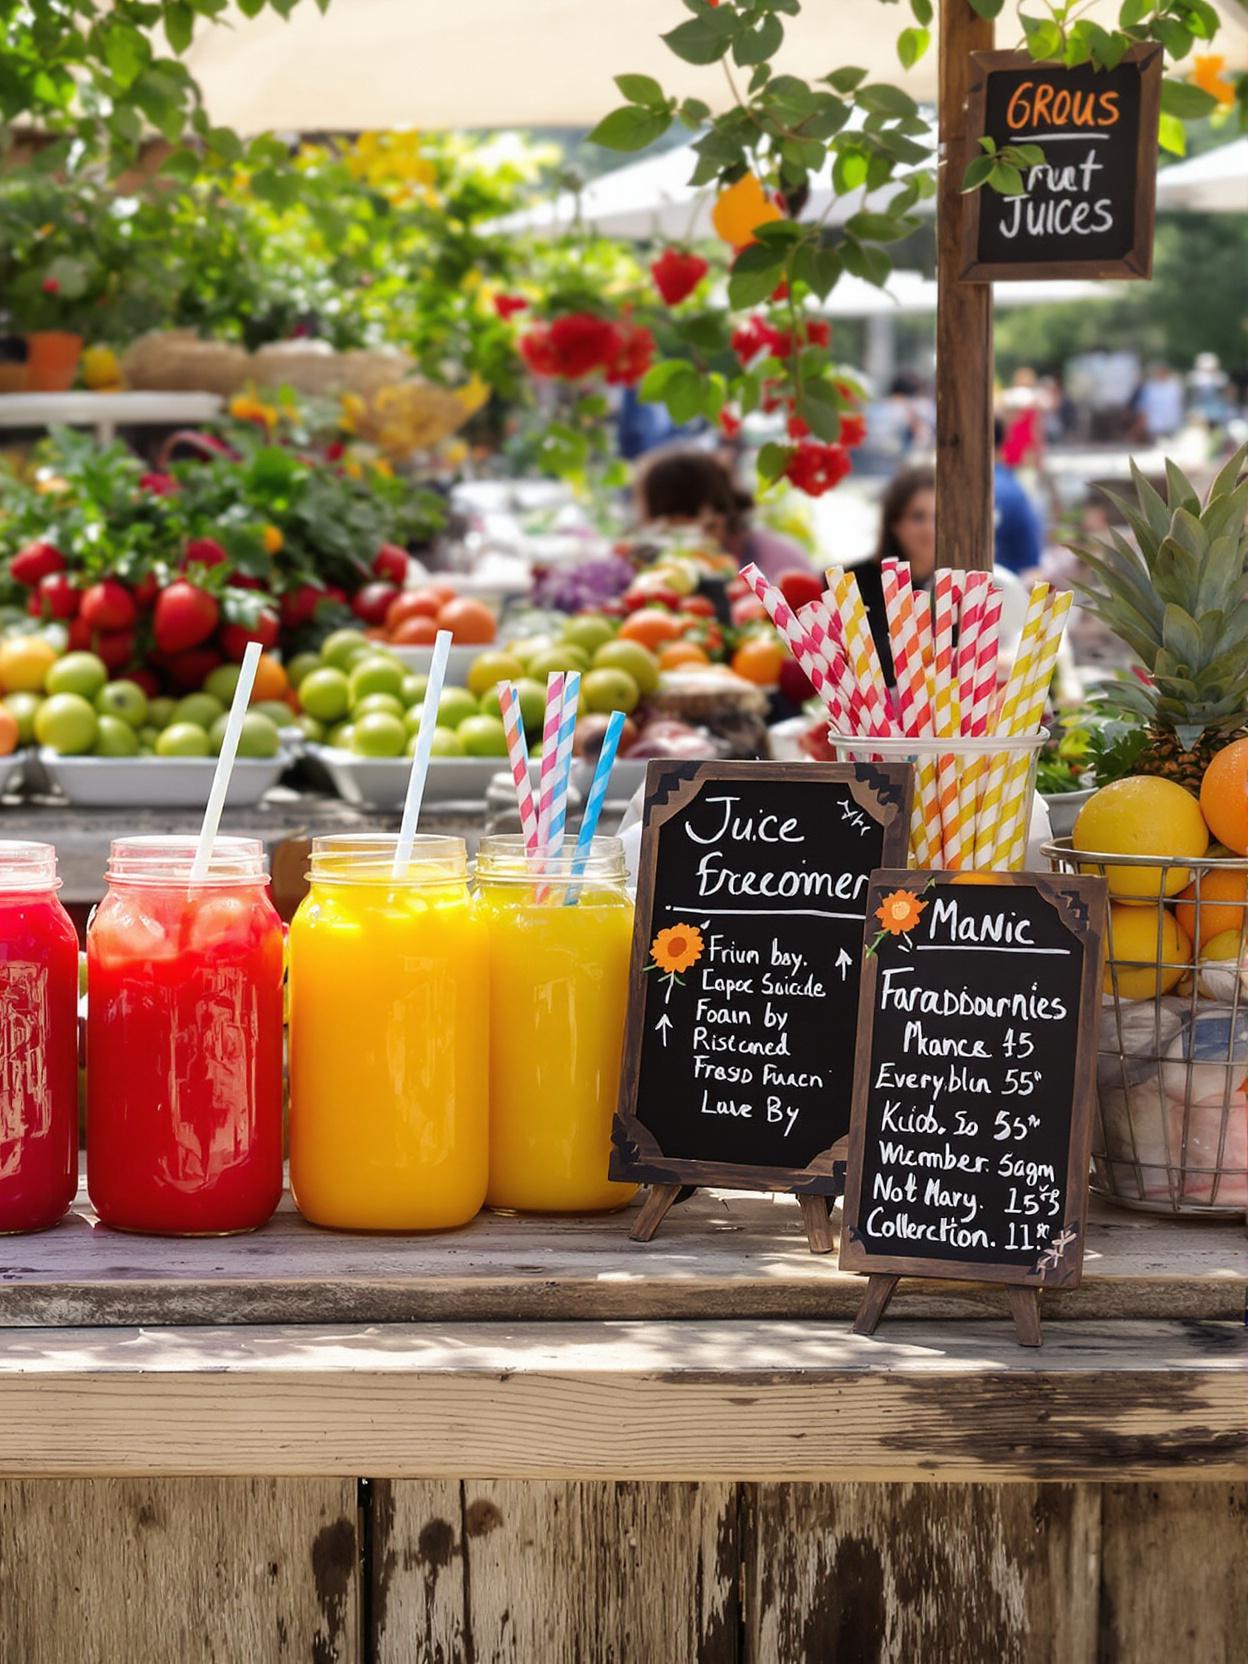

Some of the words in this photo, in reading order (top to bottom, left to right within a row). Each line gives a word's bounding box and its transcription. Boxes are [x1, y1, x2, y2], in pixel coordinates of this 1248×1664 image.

[684, 795, 806, 845] Juice
[764, 1002, 788, 1030] by
[767, 1096, 799, 1136] By
[873, 1173, 917, 1202] Not
